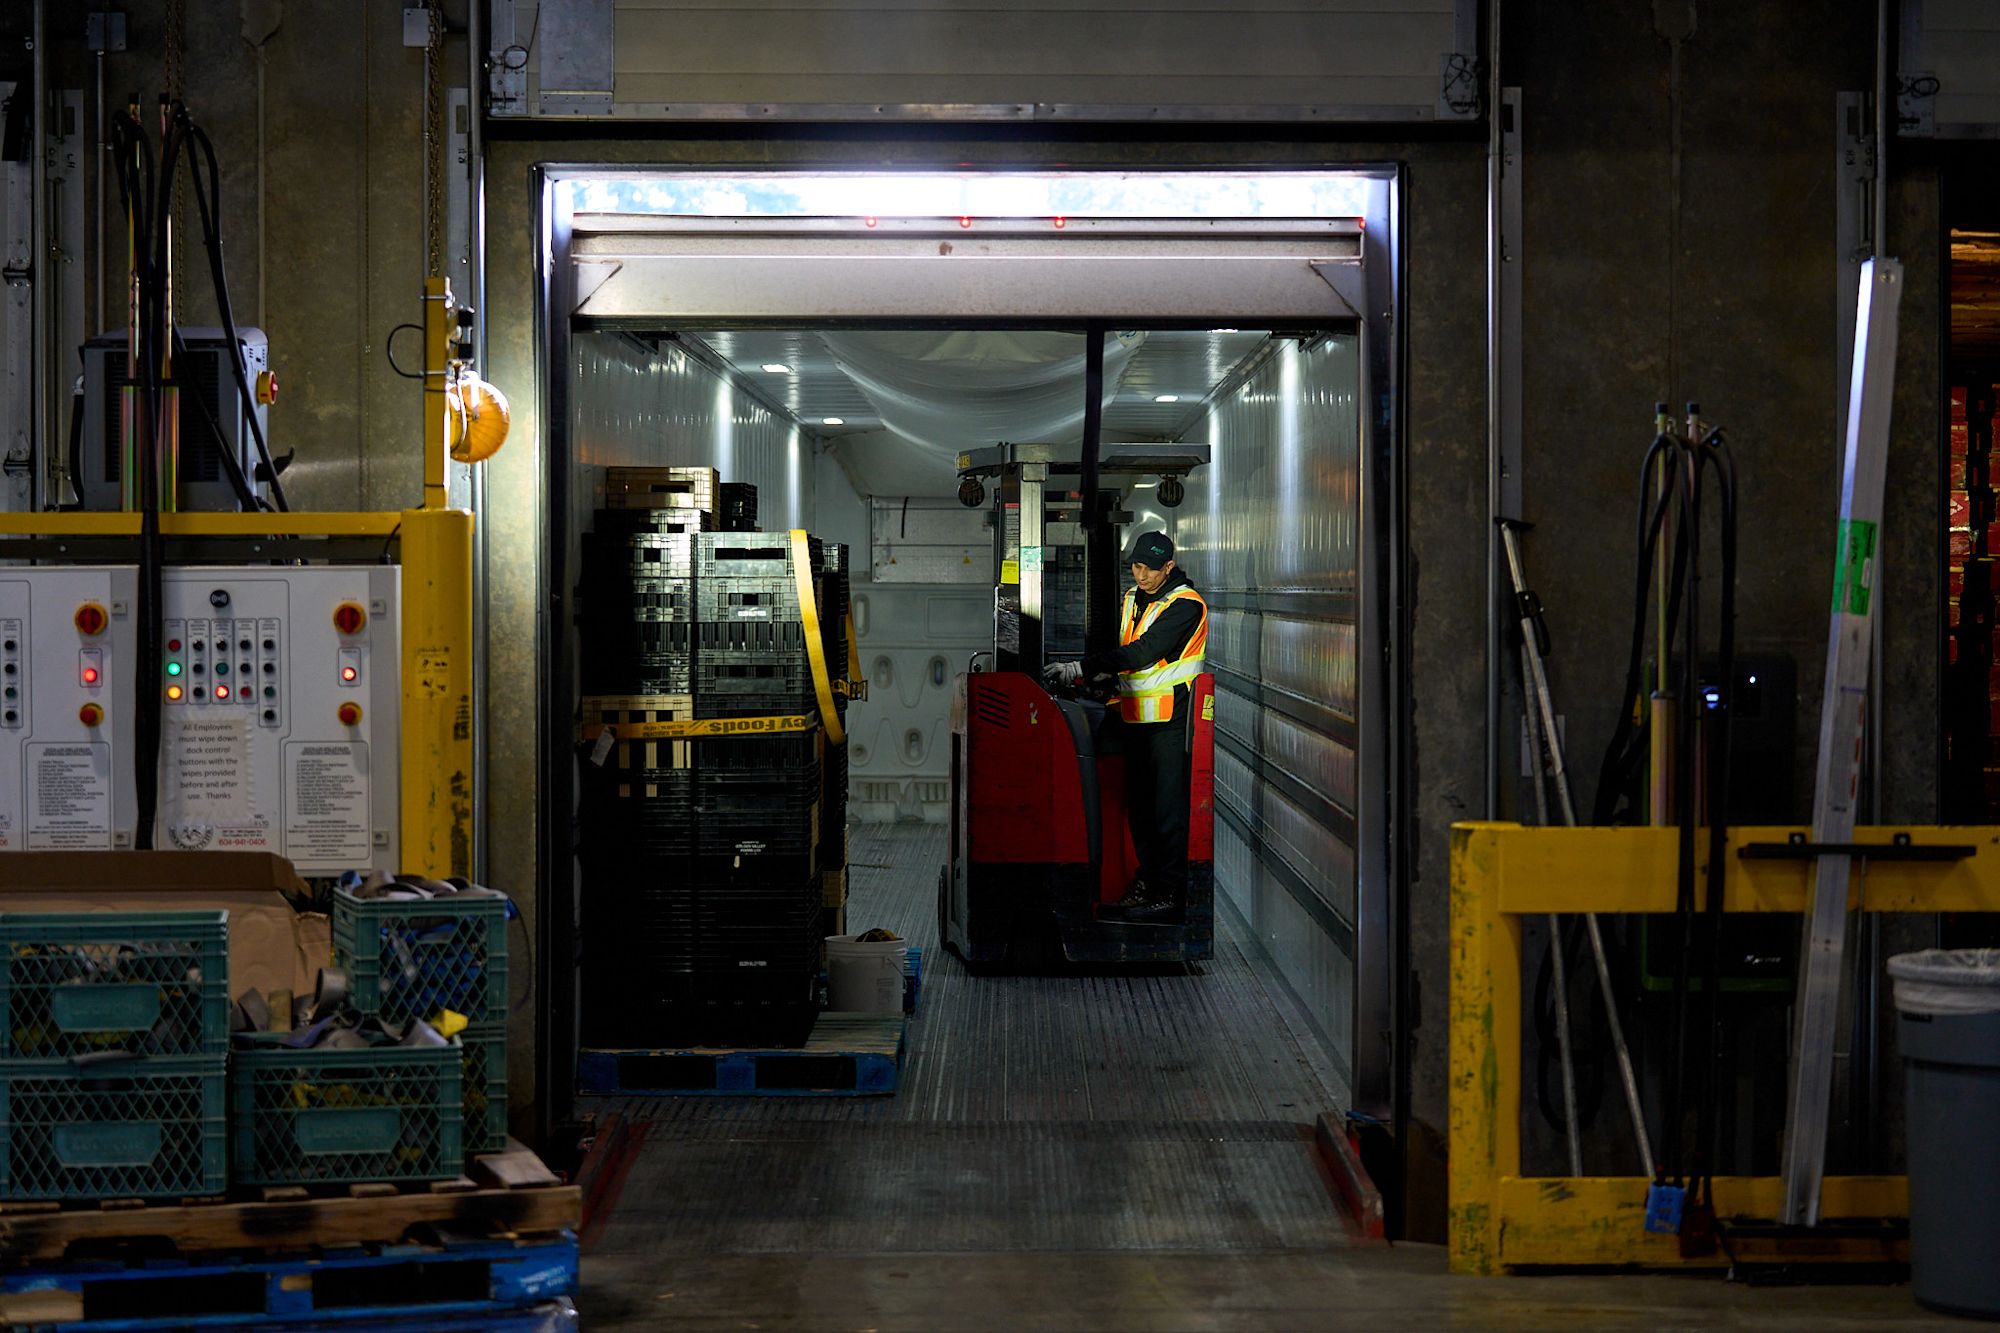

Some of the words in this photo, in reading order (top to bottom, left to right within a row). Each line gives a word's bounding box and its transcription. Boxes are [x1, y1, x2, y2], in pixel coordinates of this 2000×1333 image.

[194, 723, 233, 732] Employees
[709, 719, 775, 733] Foods
[198, 736, 215, 744] wipe
[217, 735, 238, 743] down
[205, 746, 231, 754] control
[178, 758, 206, 766] buttons
[208, 758, 224, 766] with
[225, 758, 238, 766] the
[181, 770, 202, 778] wipes
[204, 769, 236, 778] provided
[180, 781, 204, 789] before
[221, 780, 238, 788] after
[206, 792, 232, 800] Thanks
[218, 837, 266, 847] 604-941-0406
